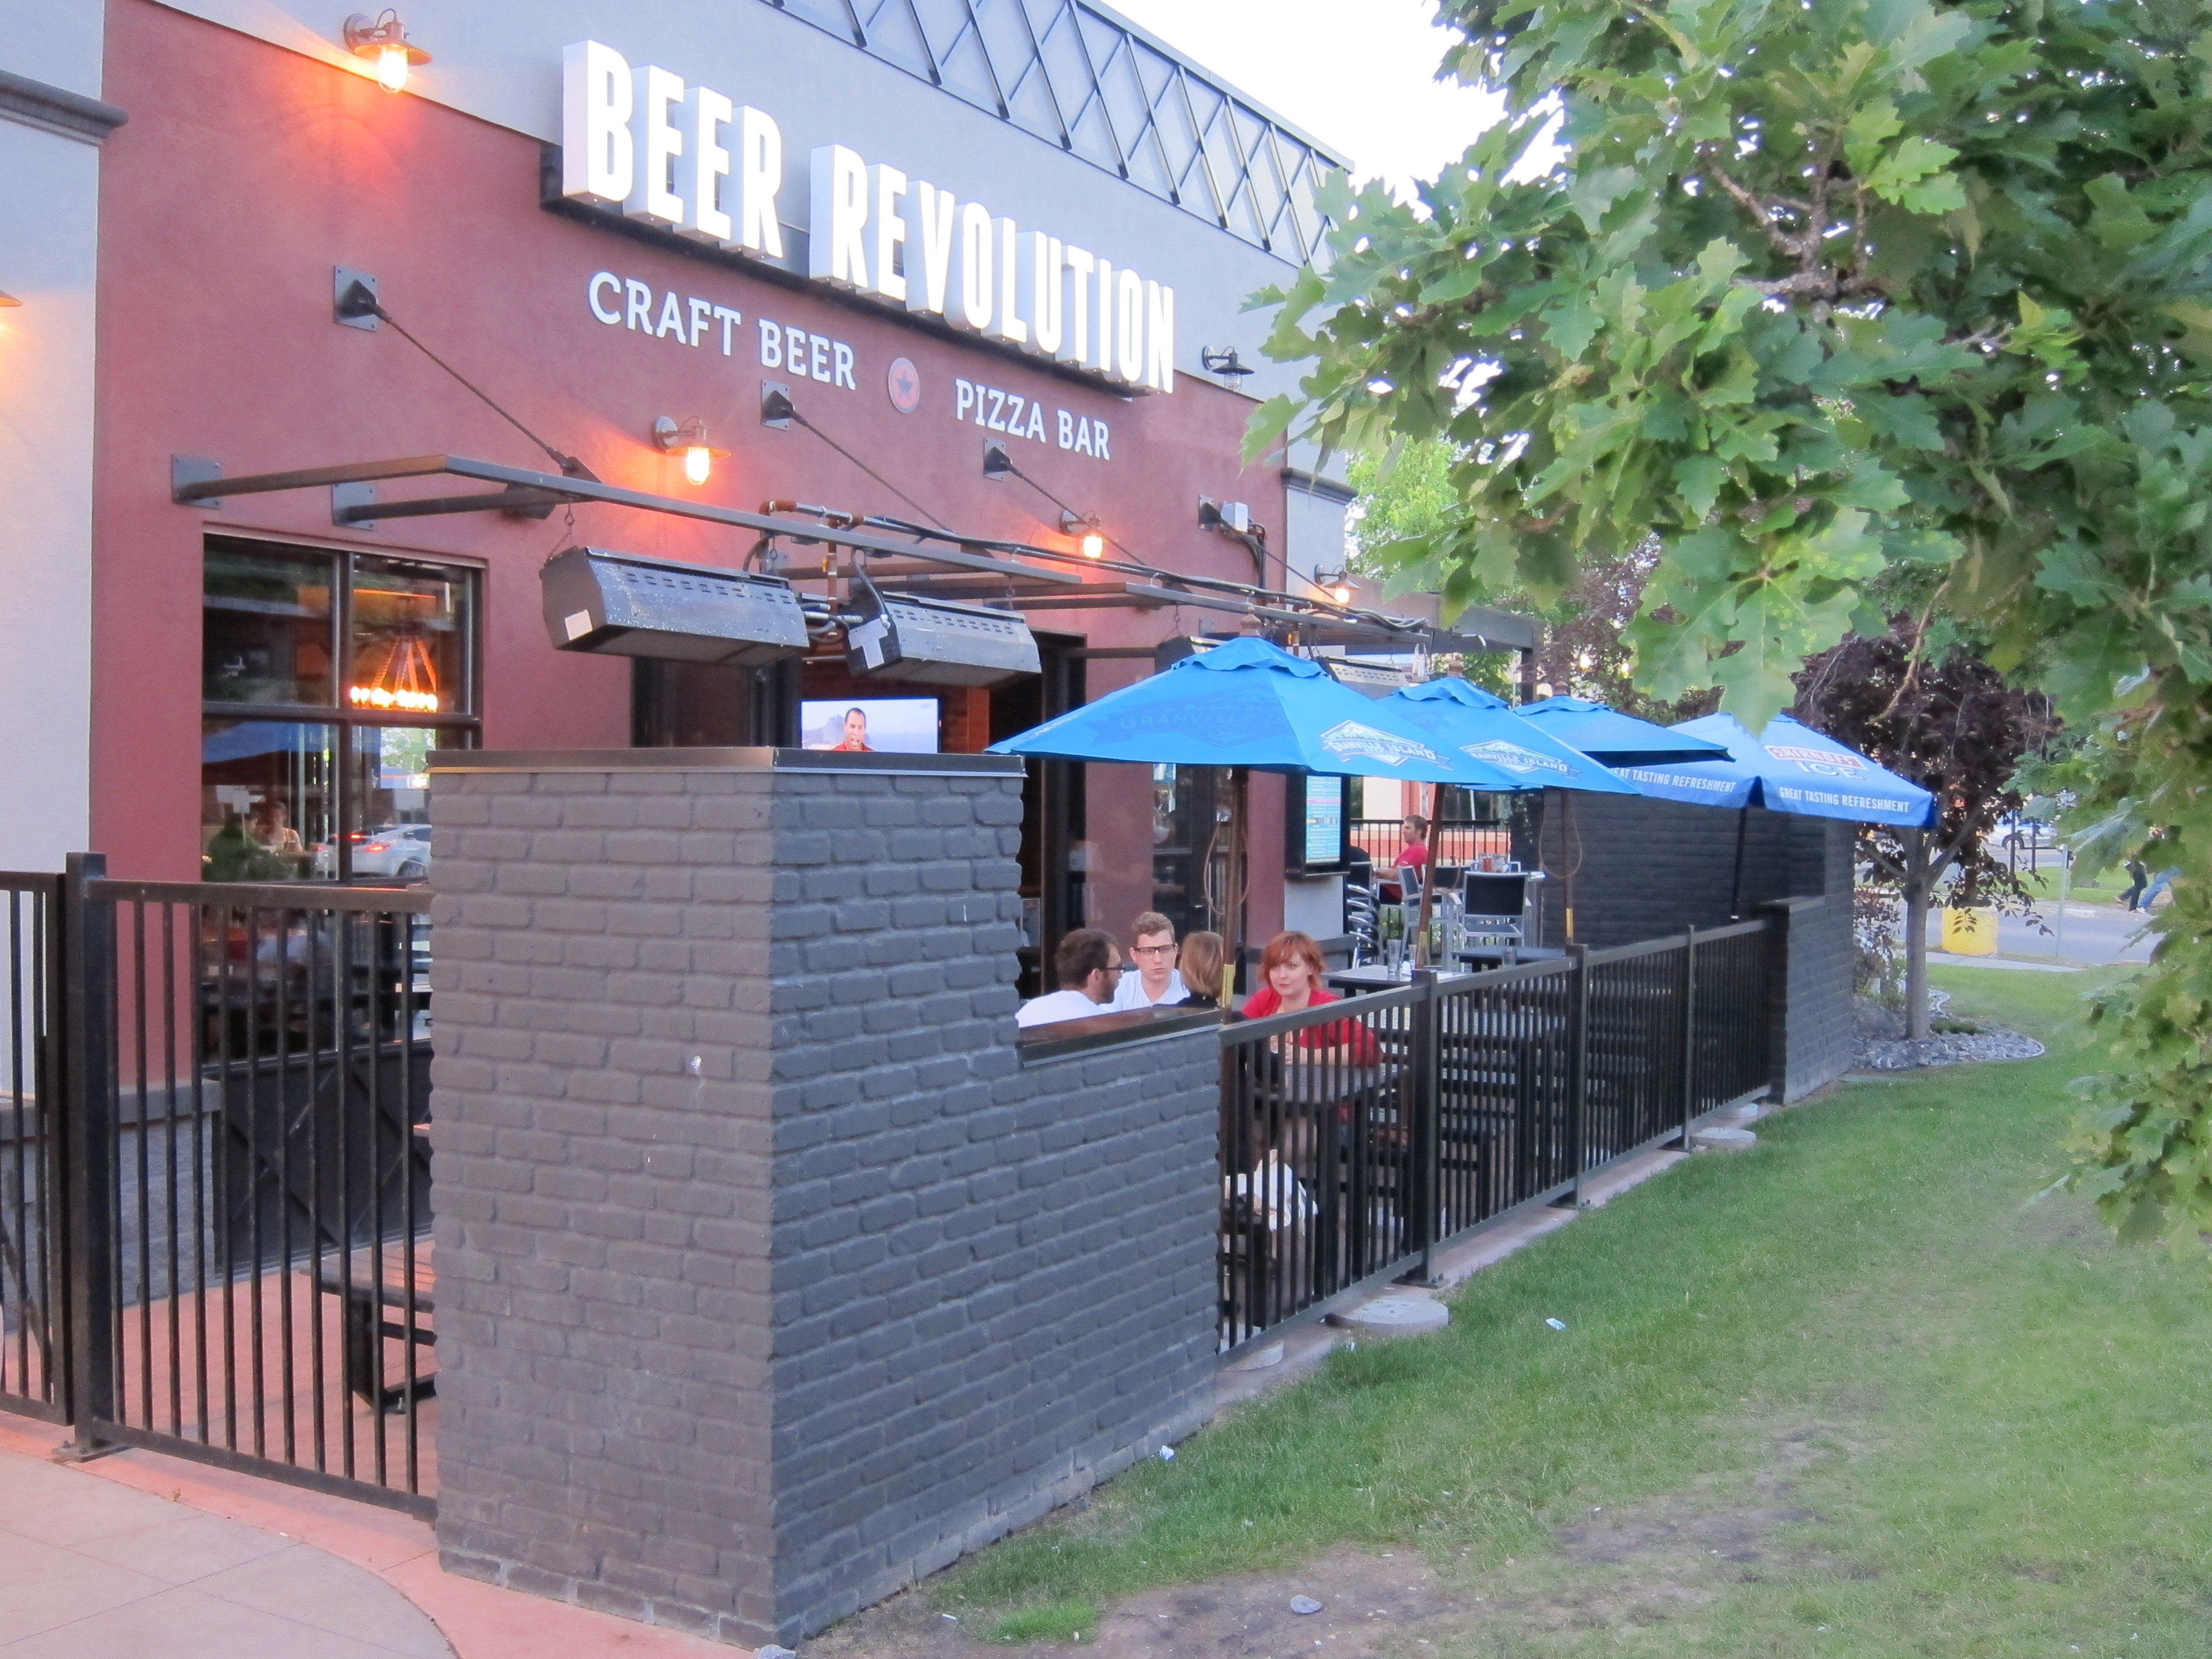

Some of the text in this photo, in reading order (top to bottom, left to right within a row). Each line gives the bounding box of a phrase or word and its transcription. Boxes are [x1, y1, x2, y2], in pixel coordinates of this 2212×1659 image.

[563, 39, 1174, 394] BEER REVOLUTION
[587, 270, 1111, 461] CRAFT BEER PIZZA BAR
[1329, 741, 1382, 752] GRANVILLE
[1386, 743, 1436, 760] ISLAND
[1772, 748, 1853, 765] SMIRNOFF
[1524, 757, 1567, 772] ISLAND
[1794, 760, 1865, 780] ICE
[1632, 769, 1670, 785] TASTING
[1672, 775, 1737, 793] REFRESHMENT
[1779, 786, 1909, 813] GREAT TASTING REFRESHMENT
